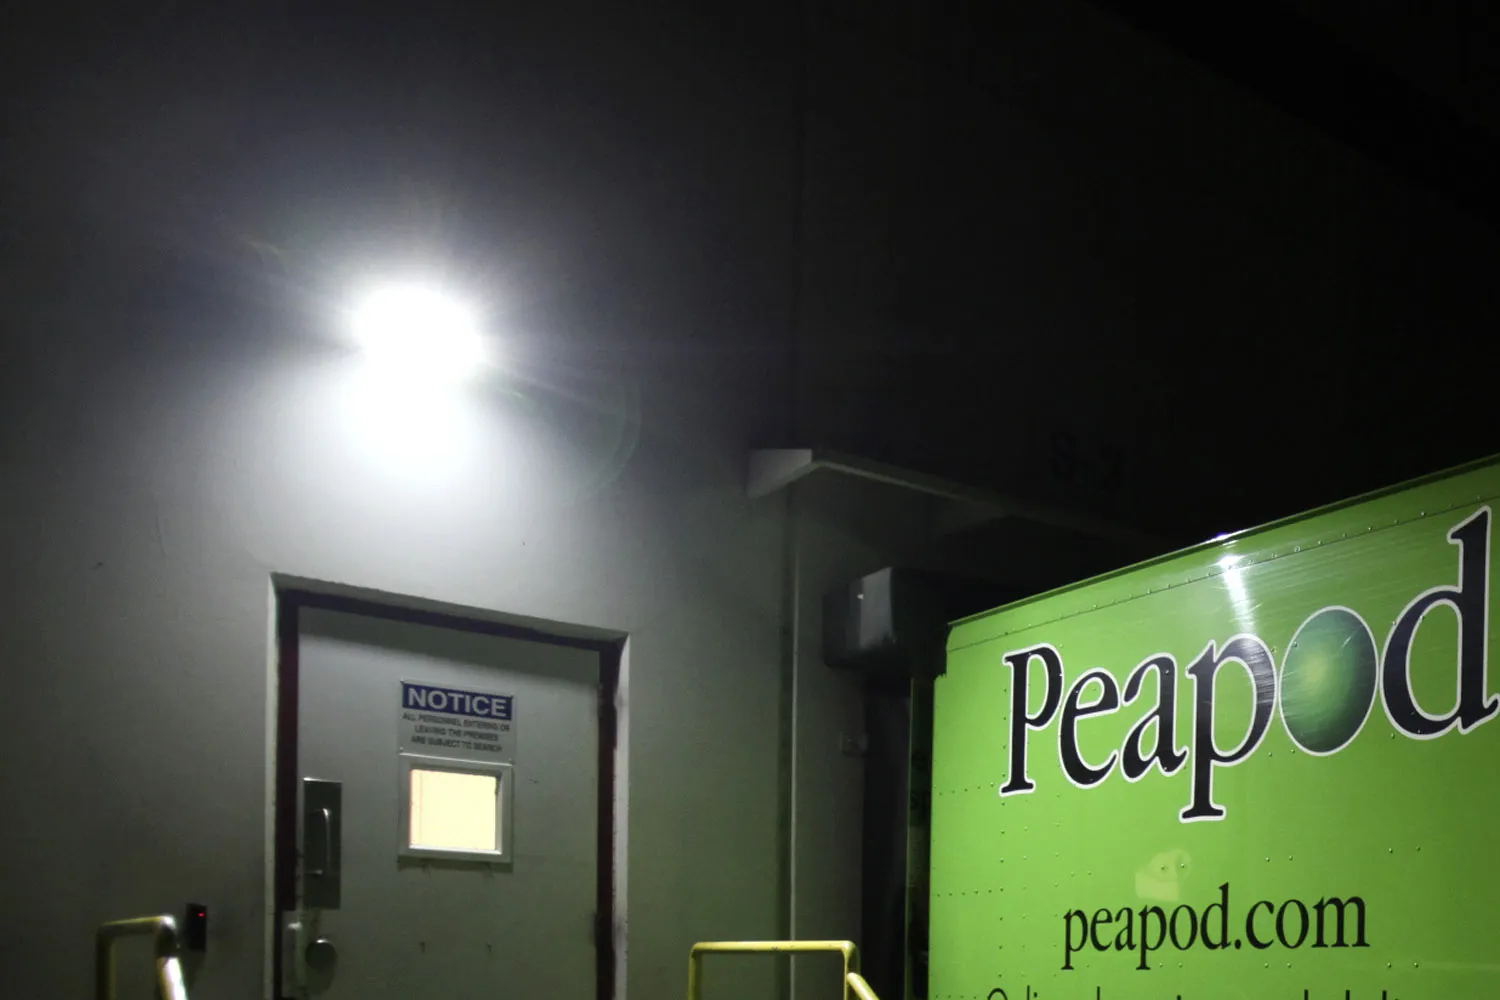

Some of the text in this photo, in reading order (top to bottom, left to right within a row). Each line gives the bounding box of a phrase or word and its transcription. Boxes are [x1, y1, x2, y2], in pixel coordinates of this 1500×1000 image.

[408, 687, 507, 717] NOTICE
[1001, 506, 1500, 822] Peapod
[1061, 882, 1371, 970] peapod.com
